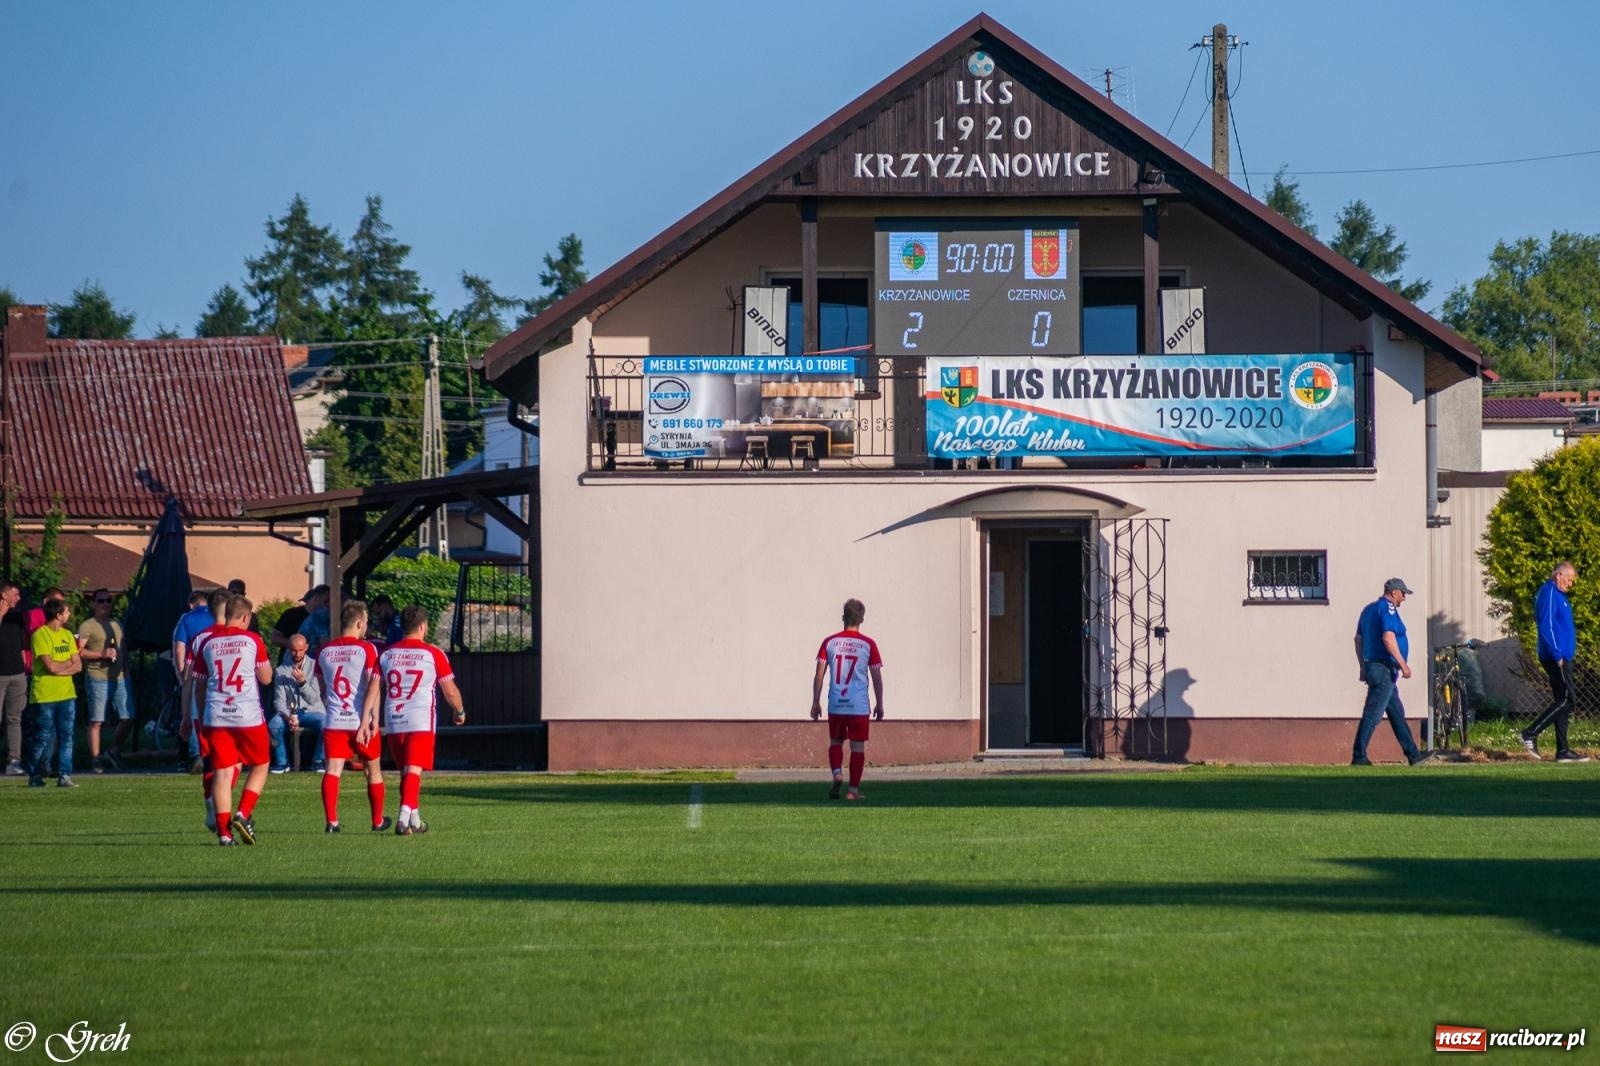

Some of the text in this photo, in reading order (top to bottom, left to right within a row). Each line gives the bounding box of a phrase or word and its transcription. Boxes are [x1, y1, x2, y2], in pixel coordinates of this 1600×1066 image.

[956, 79, 1014, 105] LKS
[933, 115, 1032, 141] 1920
[853, 146, 1111, 179] KRZYŻANOWICE
[945, 243, 1015, 273] 90:00
[878, 288, 970, 301] KRZYŻANOWICE
[1007, 289, 1066, 301] CZERNICA
[746, 307, 786, 348] BINGO
[902, 311, 924, 348] 2
[1031, 311, 1052, 347] 0
[1166, 307, 1203, 350] BINGO
[650, 357, 848, 373] MEBLE STWORZONE Z MYŚLĄ O TOBIE
[991, 362, 1282, 400] LKS KRZYŻANOWICE
[662, 418, 681, 428] 691
[683, 418, 703, 428] 660
[1156, 406, 1284, 430] 1920-2020
[660, 432, 693, 440] SYRYNIA
[661, 441, 673, 449] UL.
[933, 428, 1086, 455] Naszego Klubu
[214, 657, 244, 694] 14
[333, 665, 352, 699] 6
[387, 669, 424, 700] 87
[835, 654, 859, 685] 17
